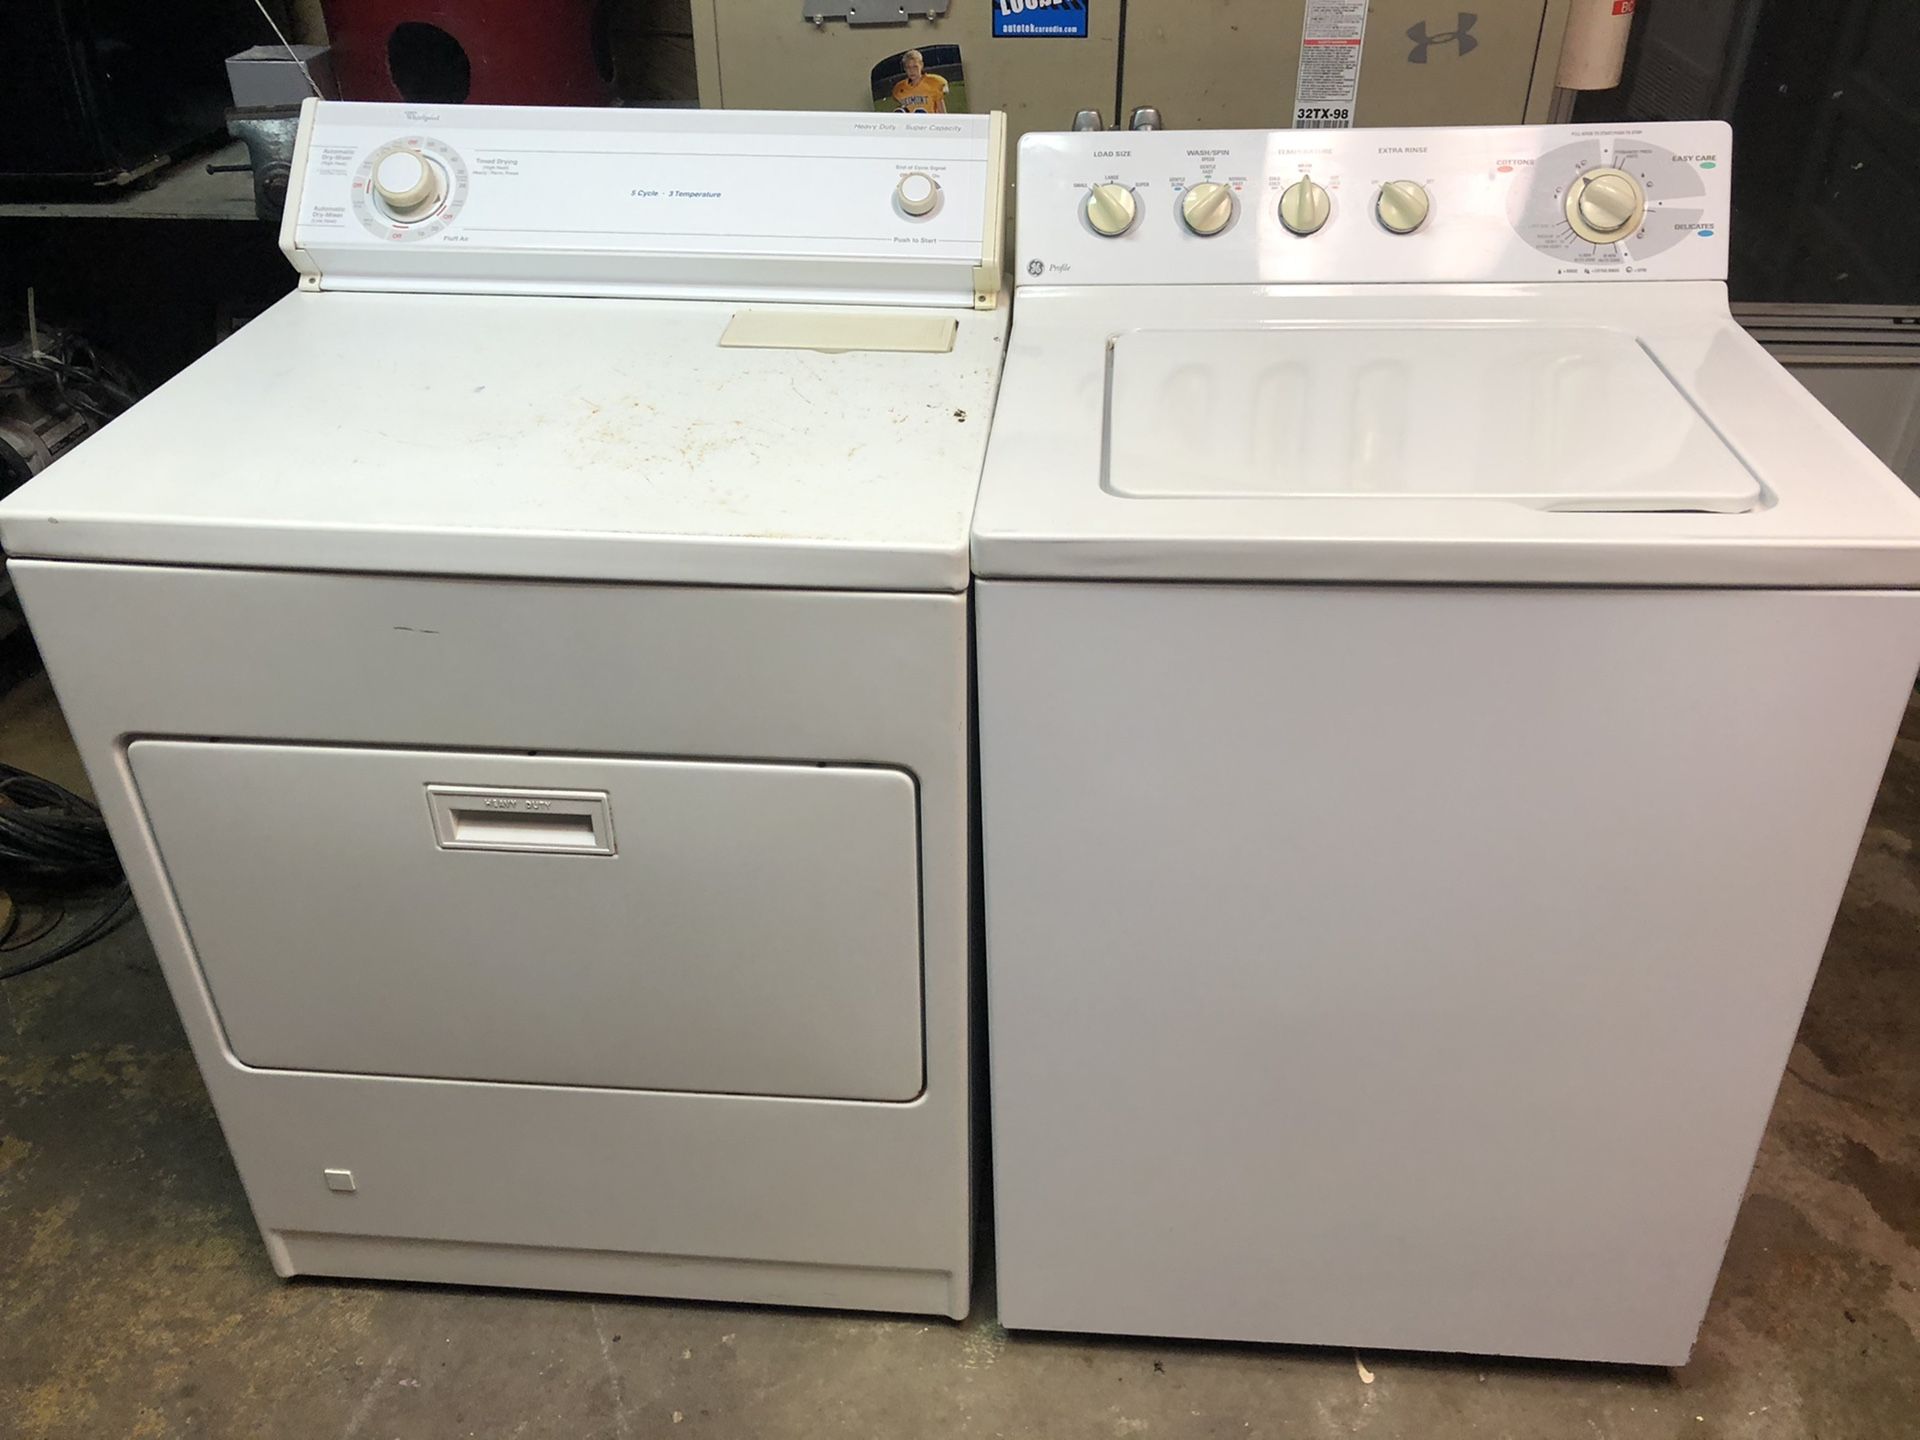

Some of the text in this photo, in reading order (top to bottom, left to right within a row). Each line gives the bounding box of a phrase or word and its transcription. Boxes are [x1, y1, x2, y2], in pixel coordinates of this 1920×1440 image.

[1297, 108, 1349, 119] 32TX-98
[1694, 154, 1717, 162] CARE
[637, 190, 658, 198] Cycle
[675, 190, 722, 198] Temperature
[1049, 264, 1072, 273] Profile
[484, 798, 551, 810] HEAVY DUTY
